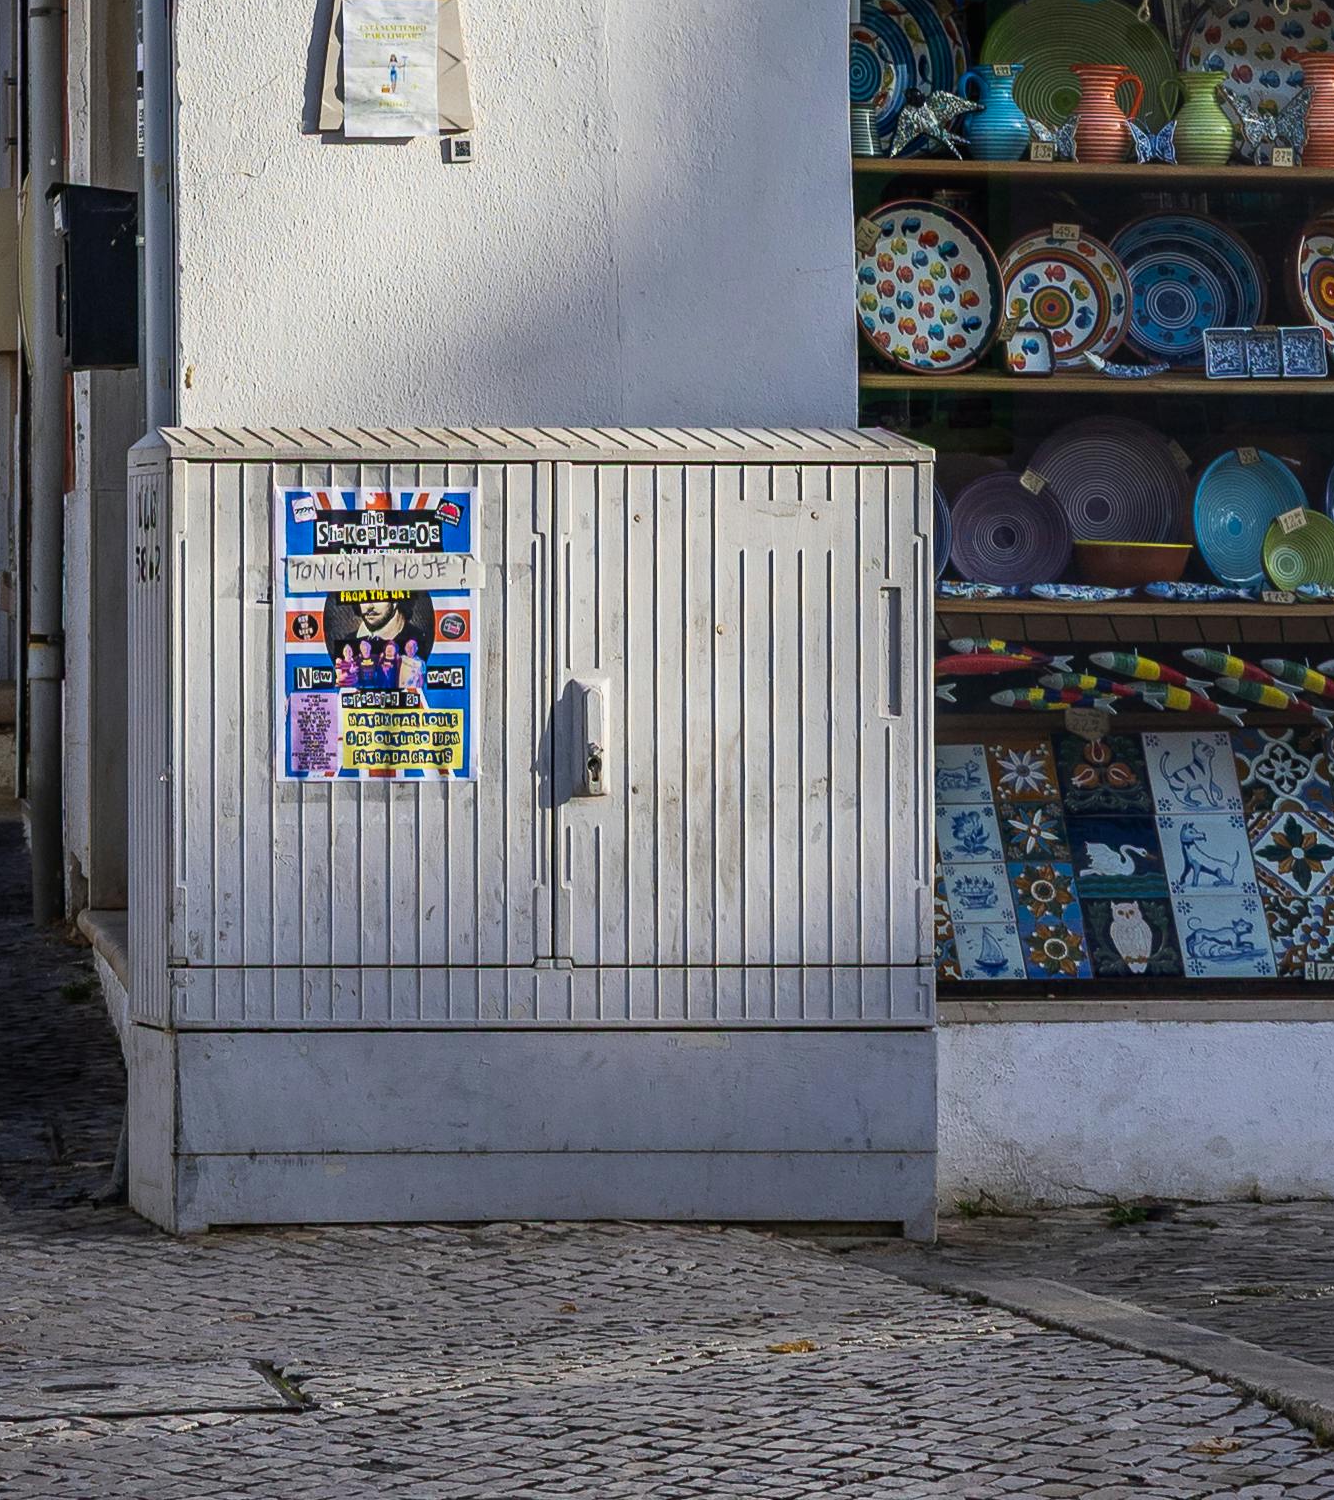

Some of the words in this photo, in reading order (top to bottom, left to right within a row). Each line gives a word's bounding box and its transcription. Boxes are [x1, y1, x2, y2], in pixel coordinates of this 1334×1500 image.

[291, 560, 381, 588] TONIGHT,
[340, 590, 367, 602] FROM
[370, 589, 389, 601] THE
[348, 713, 392, 727] MATRIX
[357, 732, 372, 746] DE
[432, 731, 460, 746] 10PM
[353, 750, 410, 765] ENTRADA
